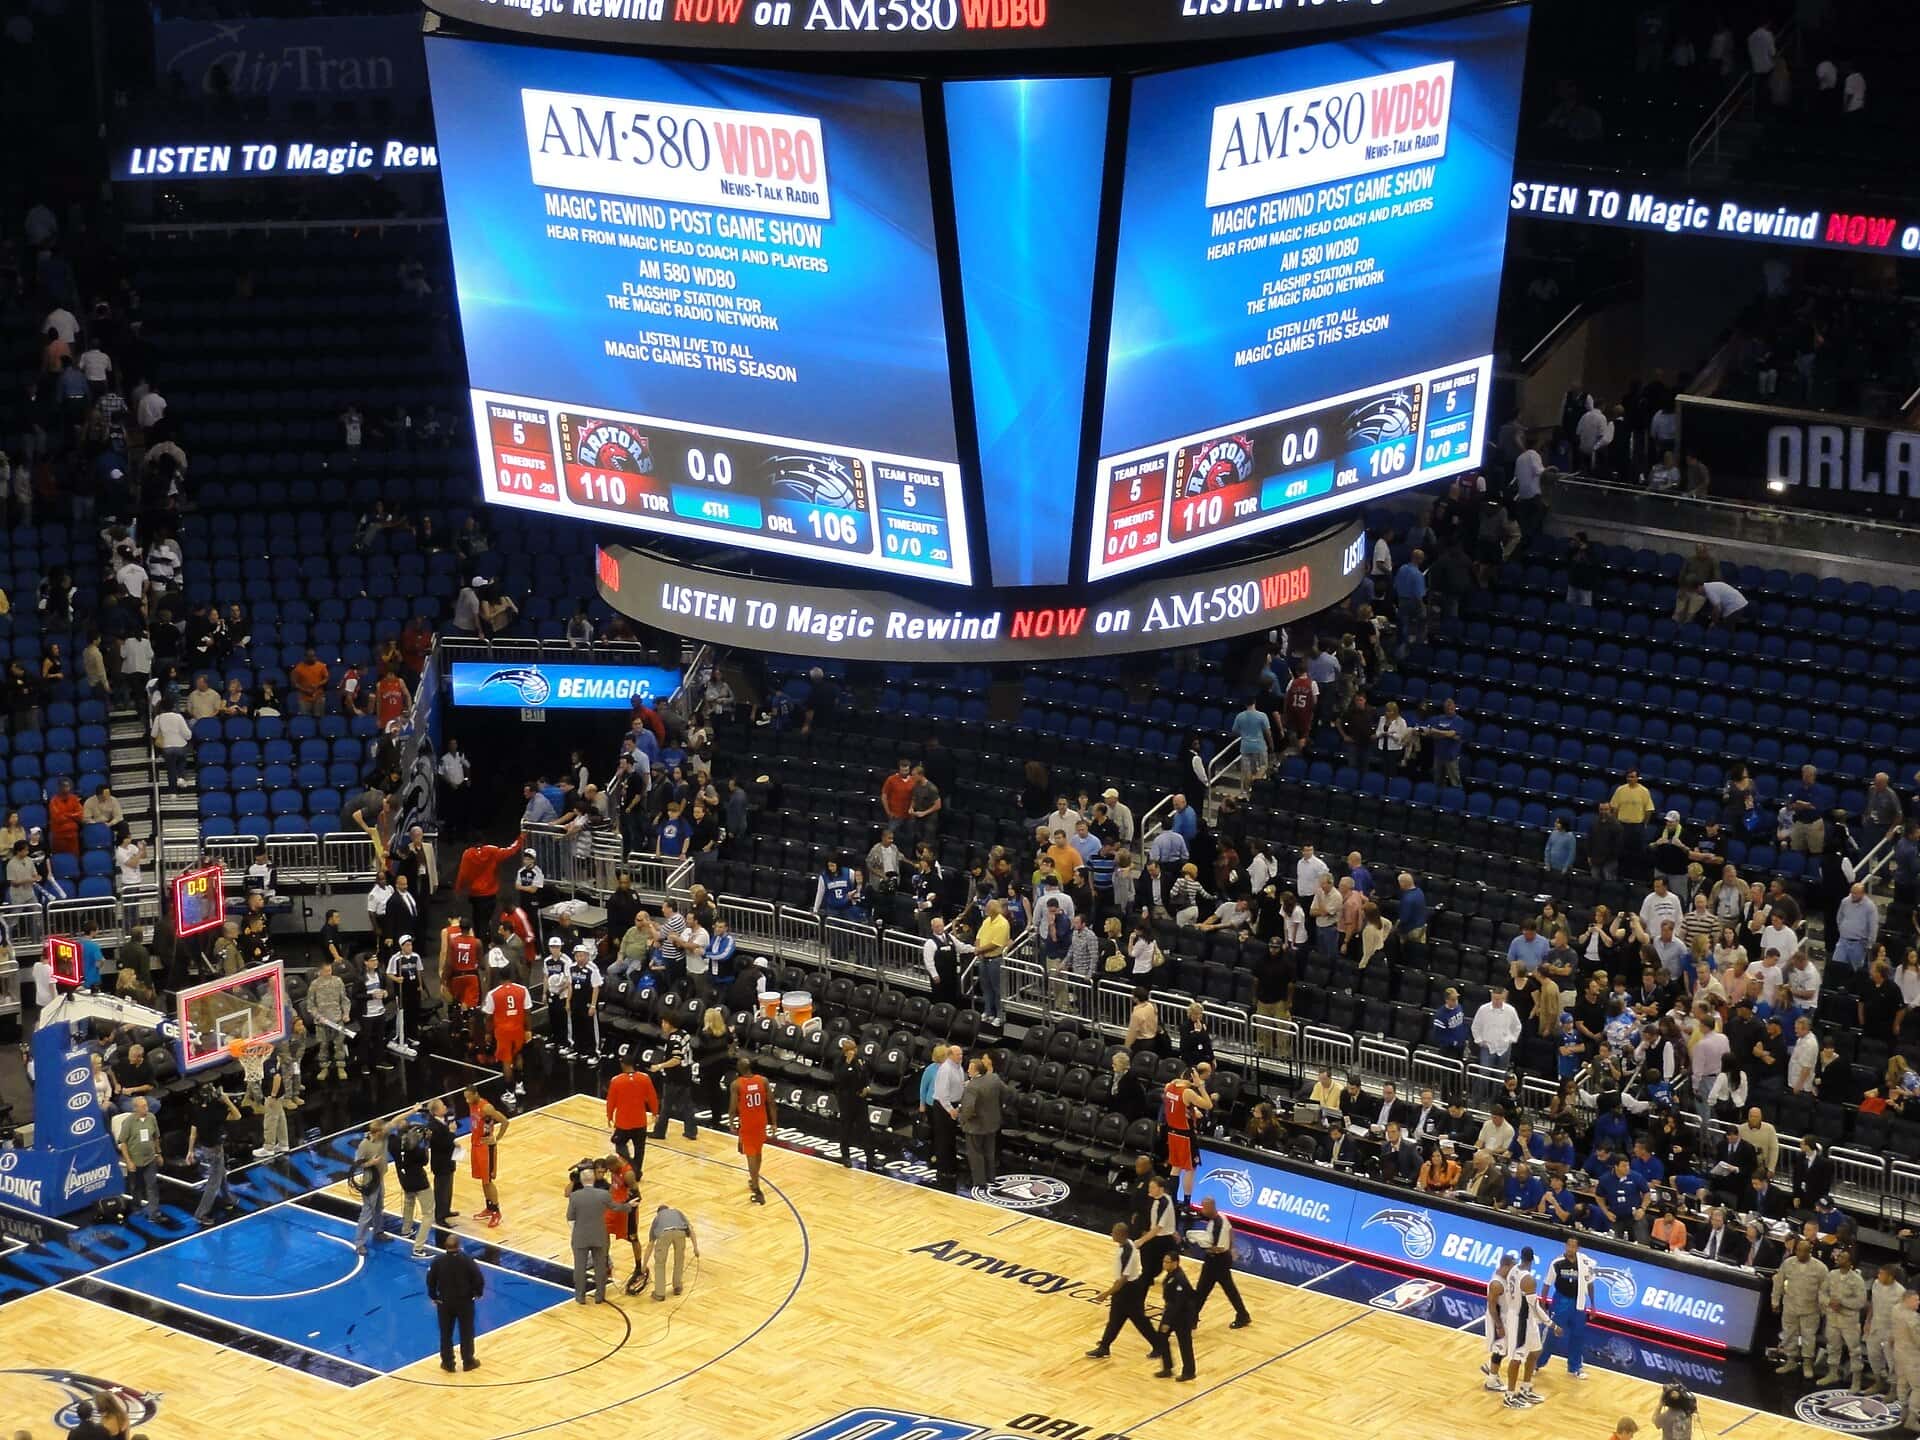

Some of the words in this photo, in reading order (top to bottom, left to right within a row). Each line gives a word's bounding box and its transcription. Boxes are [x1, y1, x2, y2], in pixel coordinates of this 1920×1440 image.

[674, 0, 744, 24] NOW
[754, 2, 791, 26] on
[961, 0, 1047, 28] WDBO
[1371, 75, 1445, 139] WDBO
[130, 146, 231, 174] LISTEN
[242, 144, 278, 171] TO
[287, 142, 373, 174] Magic
[714, 121, 816, 184] WDBO
[1211, 209, 1257, 237] MAGIC
[1259, 194, 1314, 226] REWIND
[1317, 184, 1353, 212] POST
[1355, 176, 1392, 204] GAME
[1394, 166, 1436, 195] SHOW
[545, 193, 598, 222] MAGIC
[600, 200, 666, 230] REWIND
[670, 208, 712, 235] POST
[717, 214, 766, 243] GAME
[769, 220, 822, 248] SHOW
[1207, 245, 1236, 260] HEAR
[1238, 235, 1267, 254] FROM
[1269, 227, 1302, 245] MAGIC
[1304, 220, 1331, 238] HEAD
[1333, 213, 1366, 232] COACH
[1369, 207, 1389, 223] AND
[1391, 197, 1434, 217] PLAYERS
[1588, 190, 1619, 218] TO
[1627, 194, 1708, 232] Magic
[1718, 203, 1819, 239] Rewind
[1825, 213, 1896, 247] NOW
[547, 225, 579, 242] HEAR
[582, 229, 616, 246] FROM
[619, 234, 657, 251] MAGIC
[661, 240, 694, 256] HEAD
[697, 244, 738, 262] COACH
[742, 250, 769, 265] AND
[772, 253, 829, 273] PLAYERS
[1280, 253, 1299, 272] AM
[1301, 246, 1324, 267] 580
[1325, 237, 1360, 262] WDBO
[640, 260, 661, 280] AM
[664, 263, 690, 283] 580
[693, 267, 736, 290] WDBO
[1262, 274, 1311, 296] FLAGSHIP
[1313, 263, 1352, 285] STATION
[1355, 258, 1375, 276] FOR
[622, 282, 680, 302] FLAGSHIP
[684, 291, 733, 310] STATION
[737, 299, 762, 313] FOR
[1247, 301, 1266, 315] THE
[1268, 291, 1301, 310] MAGIC
[1303, 283, 1334, 303] RADIO
[1336, 270, 1385, 293] NETWORK
[607, 295, 630, 310] THE
[633, 299, 672, 317] MAGIC
[675, 305, 713, 322] RADIO
[716, 310, 779, 331] NETWORK
[1267, 321, 1301, 342] LISTEN
[1303, 315, 1324, 333] LIVE
[1326, 312, 1339, 327] TO
[1340, 307, 1359, 322] ALL
[639, 330, 681, 348] LISTEN
[683, 337, 709, 353] LIVE
[711, 340, 728, 355] TO
[731, 344, 753, 359] ALL
[1235, 344, 1272, 367] MAGIC
[1274, 332, 1315, 357] GAMES
[1317, 325, 1342, 346] THIS
[1344, 314, 1389, 338] SEASON
[605, 341, 649, 361] MAGIC
[652, 347, 702, 369] GAMES
[704, 355, 737, 373] THIS
[740, 361, 798, 383] SEASON
[1432, 379, 1453, 394] TEAM
[1445, 391, 1456, 412] 5
[490, 407, 517, 421] TEAM
[518, 411, 546, 425] FOULS
[1430, 421, 1467, 439] TIMEOUTS
[512, 423, 526, 444] 5
[560, 414, 573, 461] BONUS
[1281, 427, 1319, 466] 0.0
[501, 454, 547, 471] TIMEOUTS
[580, 426, 653, 474] RAPTORS
[1369, 443, 1406, 477] 106
[687, 448, 732, 486] 0.0
[878, 467, 907, 484] TEAM
[909, 472, 940, 487] FOULS
[1114, 465, 1138, 481] TEAM
[1139, 458, 1164, 475] FOULS
[1188, 441, 1253, 496] RAPTORS
[1336, 467, 1359, 487] ORL
[580, 471, 626, 505] 110
[852, 459, 865, 509] BONUS
[903, 485, 917, 507] 5
[1130, 478, 1142, 501] 5
[1285, 480, 1308, 498] 4TH
[640, 493, 670, 513] TOR
[702, 502, 730, 519] 4TH
[1183, 495, 1223, 532] 110
[1234, 497, 1258, 517] TOR
[767, 514, 797, 534] ORL
[808, 510, 858, 545] 106
[887, 517, 938, 536] TIMEOUTS
[1113, 509, 1155, 530] TIMEOUTS
[662, 583, 737, 624] LISTEN
[746, 599, 778, 630] TO
[786, 605, 875, 642] Magic
[886, 611, 1001, 640] Rewind
[1010, 607, 1087, 639] NOW
[1095, 608, 1130, 633] on
[1261, 566, 1310, 610] WDBO
[457, 951, 470, 965] 14
[506, 996, 515, 1010] 9
[746, 1092, 762, 1107] 30
[1168, 1099, 1175, 1113] 7
[68, 1164, 111, 1189] Amway
[908, 1239, 1086, 1294] Amway
